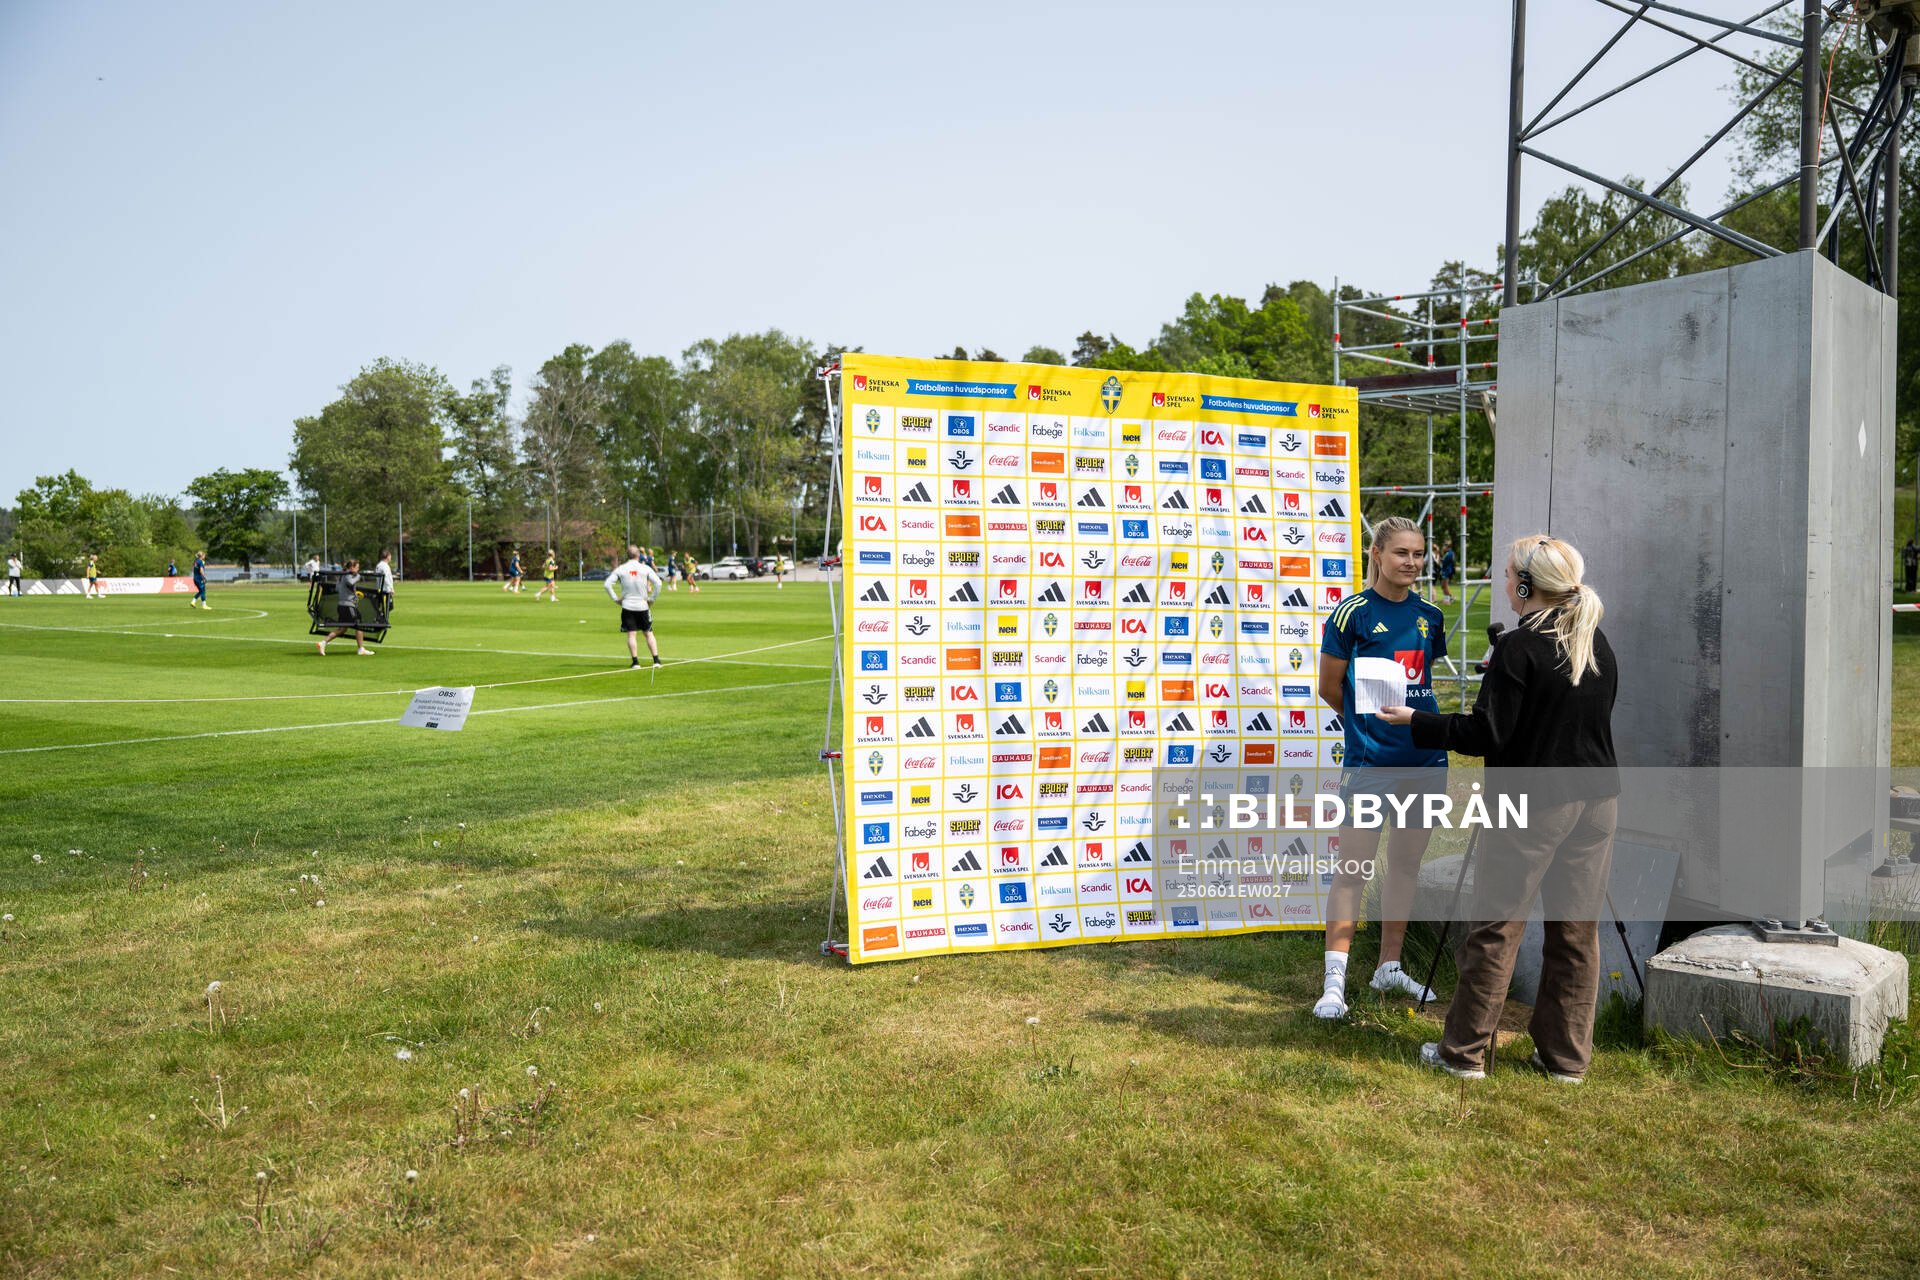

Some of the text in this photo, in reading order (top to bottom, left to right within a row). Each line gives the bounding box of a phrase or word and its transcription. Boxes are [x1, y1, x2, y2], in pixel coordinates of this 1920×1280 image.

[869, 379, 899, 387] SVENSKA
[915, 383, 1008, 395] Fotbollens huvudsponsor
[1043, 388, 1071, 396] SVENSKA
[1208, 399, 1290, 412] Fotbollens huvudsponsor
[902, 416, 932, 427] SPORT
[989, 423, 1020, 432] Scandic
[1033, 425, 1062, 438] Fabege
[1074, 427, 1105, 437] Folksam
[1202, 431, 1224, 445] ICA
[1287, 434, 1294, 442] SJ
[858, 450, 889, 461] Folksam
[1076, 458, 1104, 468] SPORT
[1277, 471, 1305, 479] Scandic
[1316, 472, 1344, 484] Fabege
[860, 516, 887, 531] ICA
[902, 520, 934, 529] Scandic
[1036, 520, 1065, 530] SPORT
[1163, 526, 1192, 538] Fabege
[1202, 528, 1230, 537] Folksam
[1244, 527, 1267, 541] ICA
[1290, 527, 1297, 535] SJ
[949, 552, 979, 562] SPORT
[993, 555, 1026, 563] Scandic
[1040, 552, 1064, 567] ICA
[1090, 551, 1097, 559] SJ
[903, 554, 934, 567] Fabege
[1239, 561, 1273, 569] BAUHAUS
[914, 616, 922, 624] SJ
[947, 622, 980, 631] Folksam
[1122, 619, 1146, 633] ICA
[1281, 624, 1308, 637] Fabege
[1131, 648, 1139, 656] SJ
[902, 656, 936, 664] Scandic
[993, 652, 1022, 662] SPORT
[1035, 655, 1066, 663] Scandic
[1078, 654, 1107, 666] Fabege
[1241, 655, 1270, 664] Folksam
[871, 685, 879, 694] SJ
[904, 687, 935, 697] SPORT
[952, 686, 978, 700] ICA
[1079, 687, 1109, 696] Folksam
[1206, 684, 1229, 698] ICA
[1242, 687, 1272, 695] Scandic
[1421, 689, 1432, 697] SPE
[1124, 748, 1152, 758] SPORT
[950, 756, 984, 765] Folksam
[993, 754, 1031, 762] BAUHAUS
[961, 784, 970, 792] SJ
[997, 785, 1023, 799] ICA
[1040, 783, 1068, 794] SPORT
[1121, 784, 1151, 792] Scandic
[1120, 816, 1151, 824] Folksam
[950, 820, 980, 831] SPORT
[905, 826, 936, 838] Fabege
[1041, 886, 1071, 895] Folksam
[1081, 884, 1111, 892] Scandic
[1127, 879, 1152, 893] ICA
[1055, 914, 1064, 922] SJ
[1127, 911, 1156, 921] SPORT
[1085, 917, 1115, 928] Fabege
[1001, 923, 1033, 932] Scandic
[906, 929, 945, 938] BAUHAUS
